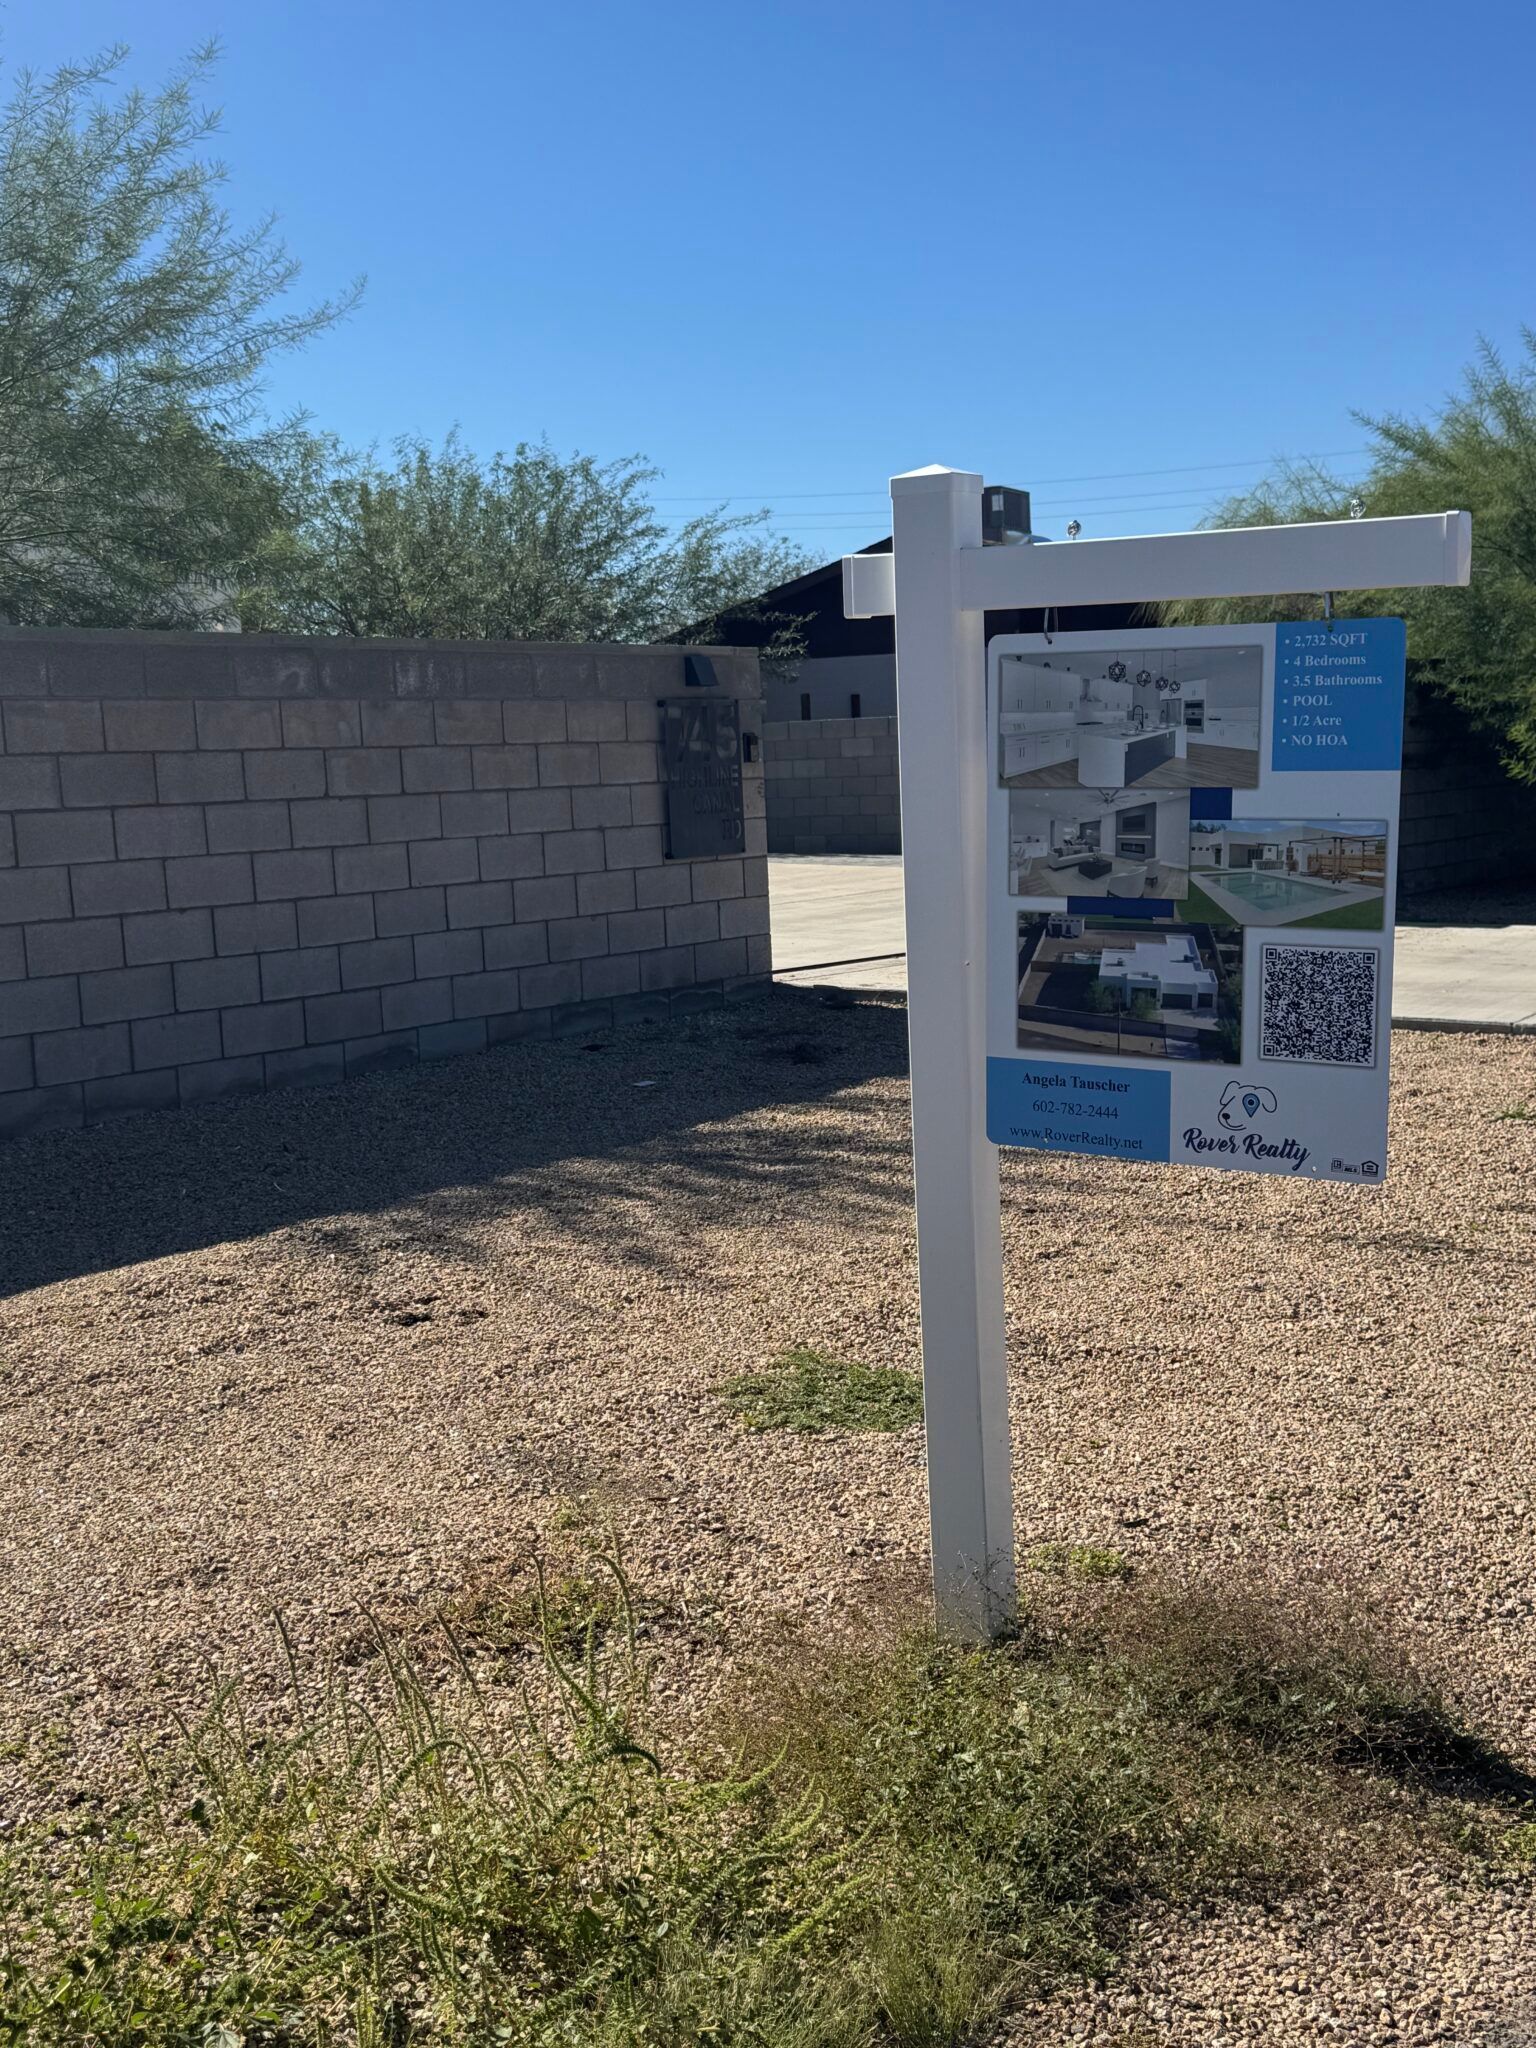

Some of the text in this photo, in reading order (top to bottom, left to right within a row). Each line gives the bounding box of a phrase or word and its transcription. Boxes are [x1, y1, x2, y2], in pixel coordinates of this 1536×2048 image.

[1295, 632, 1368, 648] 2,732 SQFT
[1293, 655, 1367, 667] 4 Bedrooms
[1293, 674, 1383, 687] 3.5 Bathrooms
[1293, 695, 1333, 706] POOL
[1292, 715, 1342, 727] 1/2 Acre
[1291, 735, 1348, 746] NO HOA
[1022, 1072, 1130, 1093] Angela Tauscher
[1032, 1099, 1119, 1119] 602-782-2444
[1009, 1126, 1143, 1150] www.RoverRealty.net
[1183, 1127, 1240, 1154] Rover
[1242, 1133, 1311, 1172] Realty
